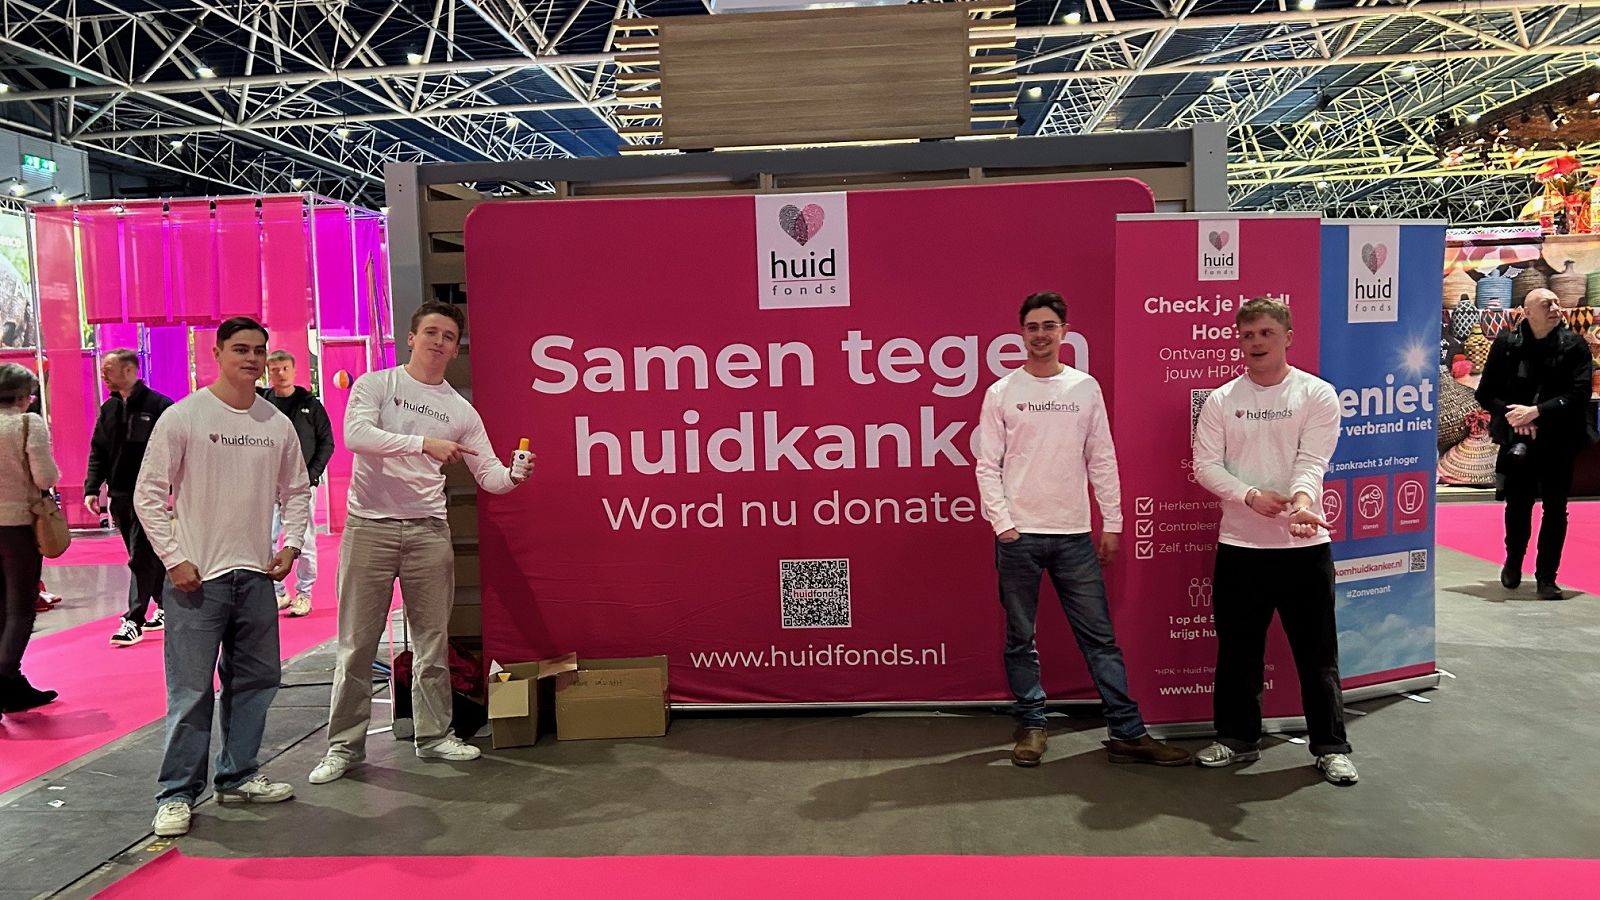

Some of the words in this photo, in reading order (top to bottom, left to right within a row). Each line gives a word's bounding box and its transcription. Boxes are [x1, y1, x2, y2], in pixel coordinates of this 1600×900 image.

[771, 249, 835, 278] huid
[1204, 253, 1234, 267] huid
[772, 284, 836, 295] fonds
[1355, 277, 1392, 299] huid
[1144, 295, 1210, 314] Check
[1213, 294, 1233, 316] je
[1355, 303, 1391, 312] fonds
[1159, 347, 1226, 361] Ontvang
[531, 335, 815, 394] Samen
[841, 330, 1089, 398] tegen
[1164, 367, 1203, 382] jouw
[1339, 373, 1434, 418] eniet
[403, 400, 450, 423] huidfonds
[1028, 401, 1080, 413] huidfonds
[1346, 419, 1404, 436] verbrand
[1407, 417, 1432, 431] niet
[221, 435, 275, 447] huidfonds
[575, 406, 982, 476] huidkank
[1336, 461, 1377, 471] zonkracht
[1378, 458, 1383, 467] 3
[1385, 456, 1393, 466] of
[1394, 456, 1419, 465] hoger
[602, 493, 723, 530] Word
[742, 500, 797, 526] nu
[813, 490, 990, 525] donate
[1159, 501, 1200, 511] Herken
[1159, 522, 1217, 532] Controleer
[1159, 543, 1182, 553] Zelf,
[1184, 542, 1213, 551] thuis
[1335, 559, 1402, 576] komhuidkanker.nl
[793, 589, 839, 599] huidfonds
[1346, 585, 1392, 598] #Zonvenant
[1176, 616, 1191, 625] op
[1193, 614, 1207, 623] de
[1170, 629, 1200, 640] krijgt
[1202, 628, 1217, 637] hu
[690, 643, 946, 668] www.huidfonds.nl
